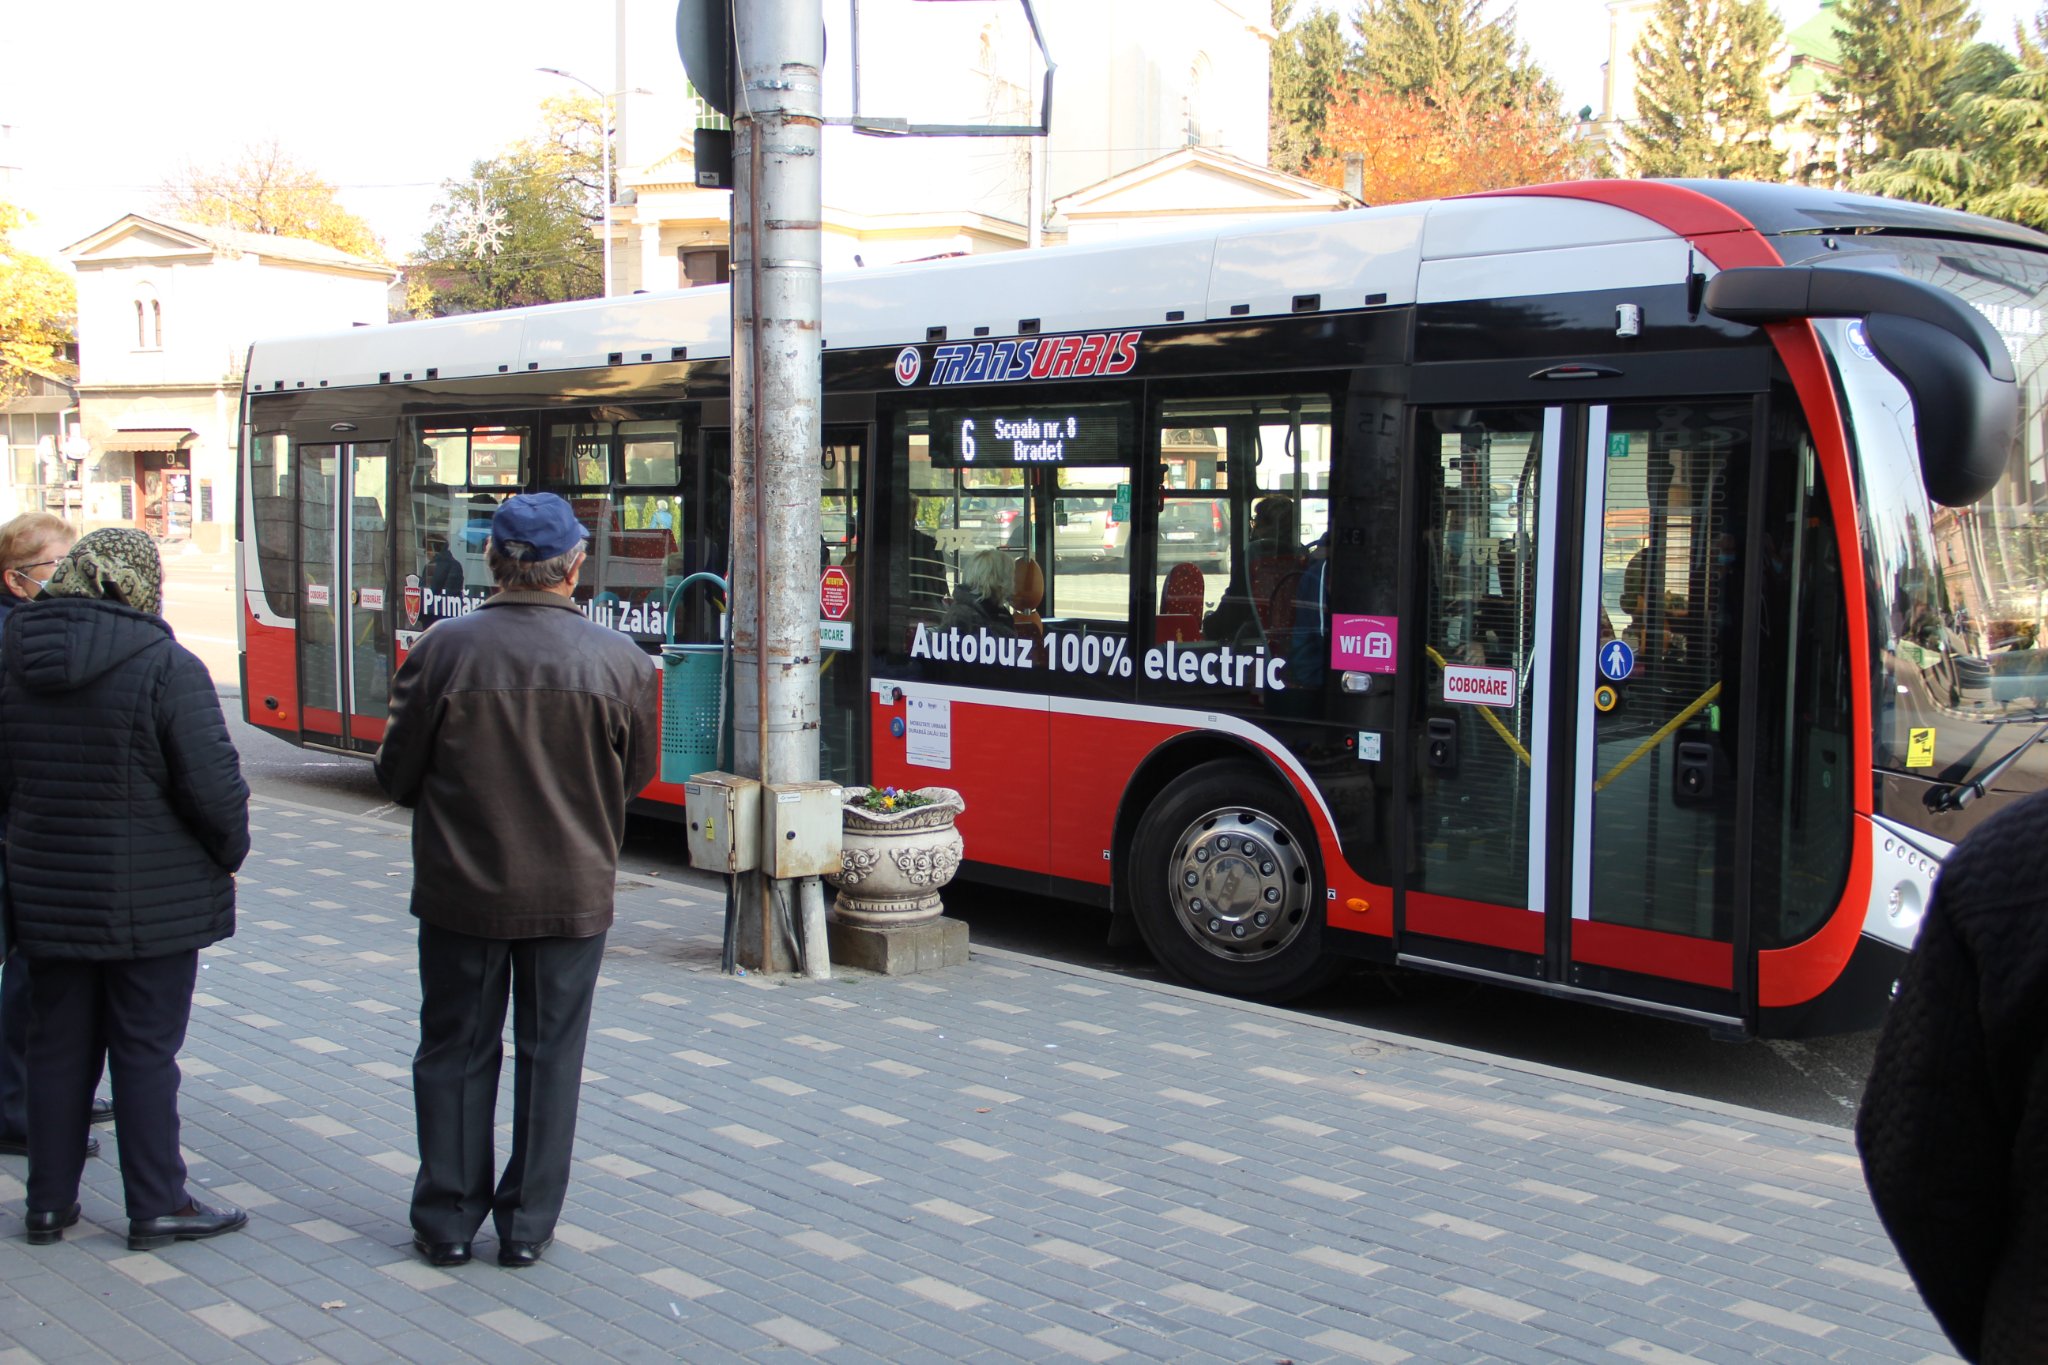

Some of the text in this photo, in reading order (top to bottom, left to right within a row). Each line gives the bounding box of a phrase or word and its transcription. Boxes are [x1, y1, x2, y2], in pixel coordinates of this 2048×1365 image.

[929, 331, 1142, 386] TRANSURBIS
[962, 419, 975, 462] 6
[994, 417, 1076, 440] Scoala nr. 8
[1013, 440, 1063, 461] Bradet
[423, 588, 485, 617] Primări
[911, 622, 1287, 690] Autobuz 100% electric
[1449, 676, 1508, 697] COBORÂRE
